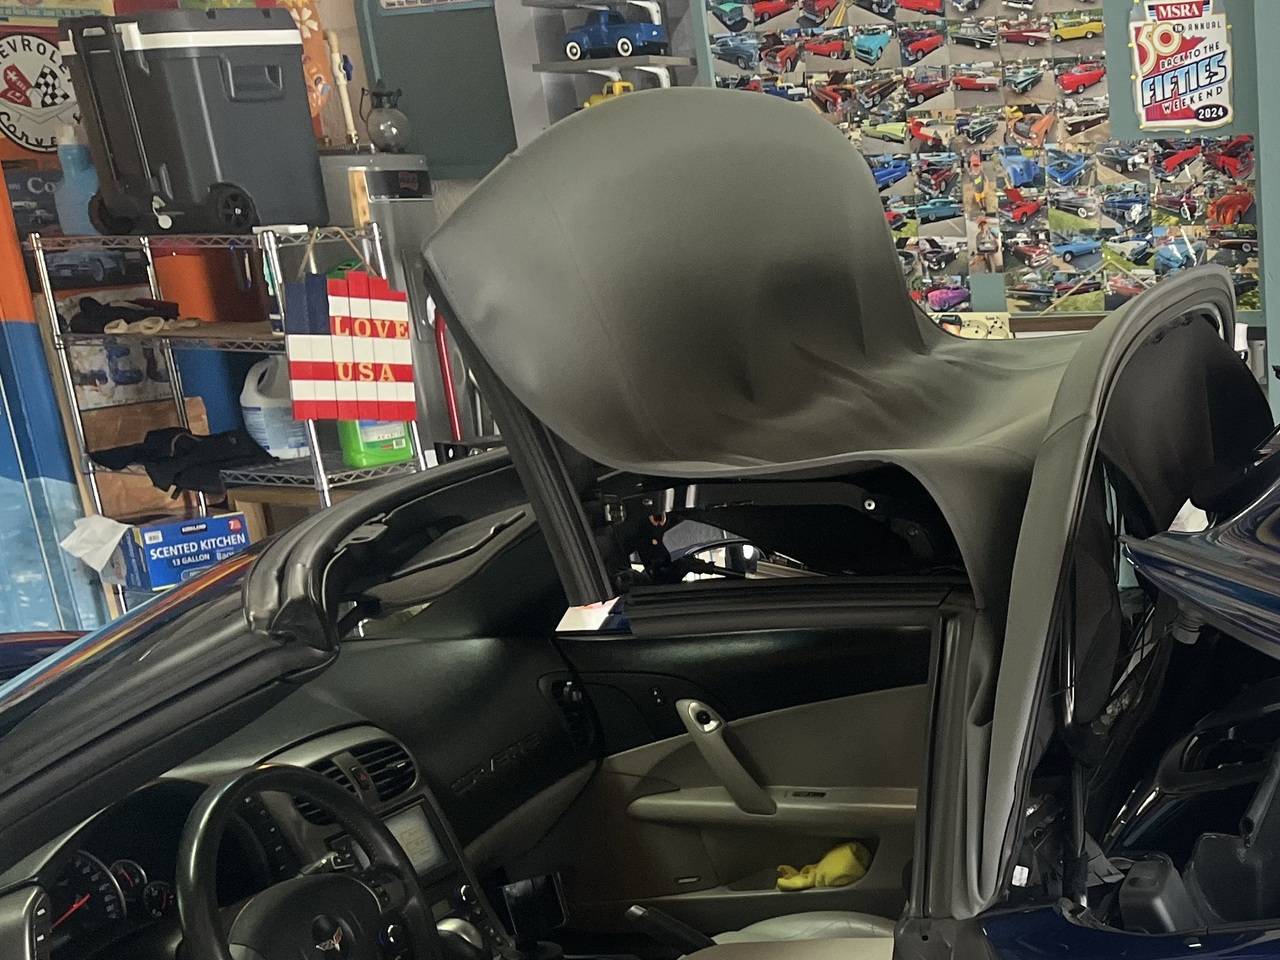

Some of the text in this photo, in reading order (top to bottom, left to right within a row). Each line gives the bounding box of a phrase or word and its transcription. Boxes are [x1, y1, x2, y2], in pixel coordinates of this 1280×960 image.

[1158, 4, 1200, 19] MSRA
[1138, 22, 1182, 76] 50
[1188, 21, 1221, 31] ANNUAL
[1161, 41, 1220, 69] BACK TO THE
[1141, 51, 1227, 107] FIFTIES
[1162, 87, 1223, 113] WEEKEND
[1198, 107, 1224, 119] 2024
[334, 316, 409, 340] LOVE
[336, 362, 395, 382] USA
[150, 533, 246, 560] SCENTED KITCHEN
[181, 553, 210, 565] GALLON
